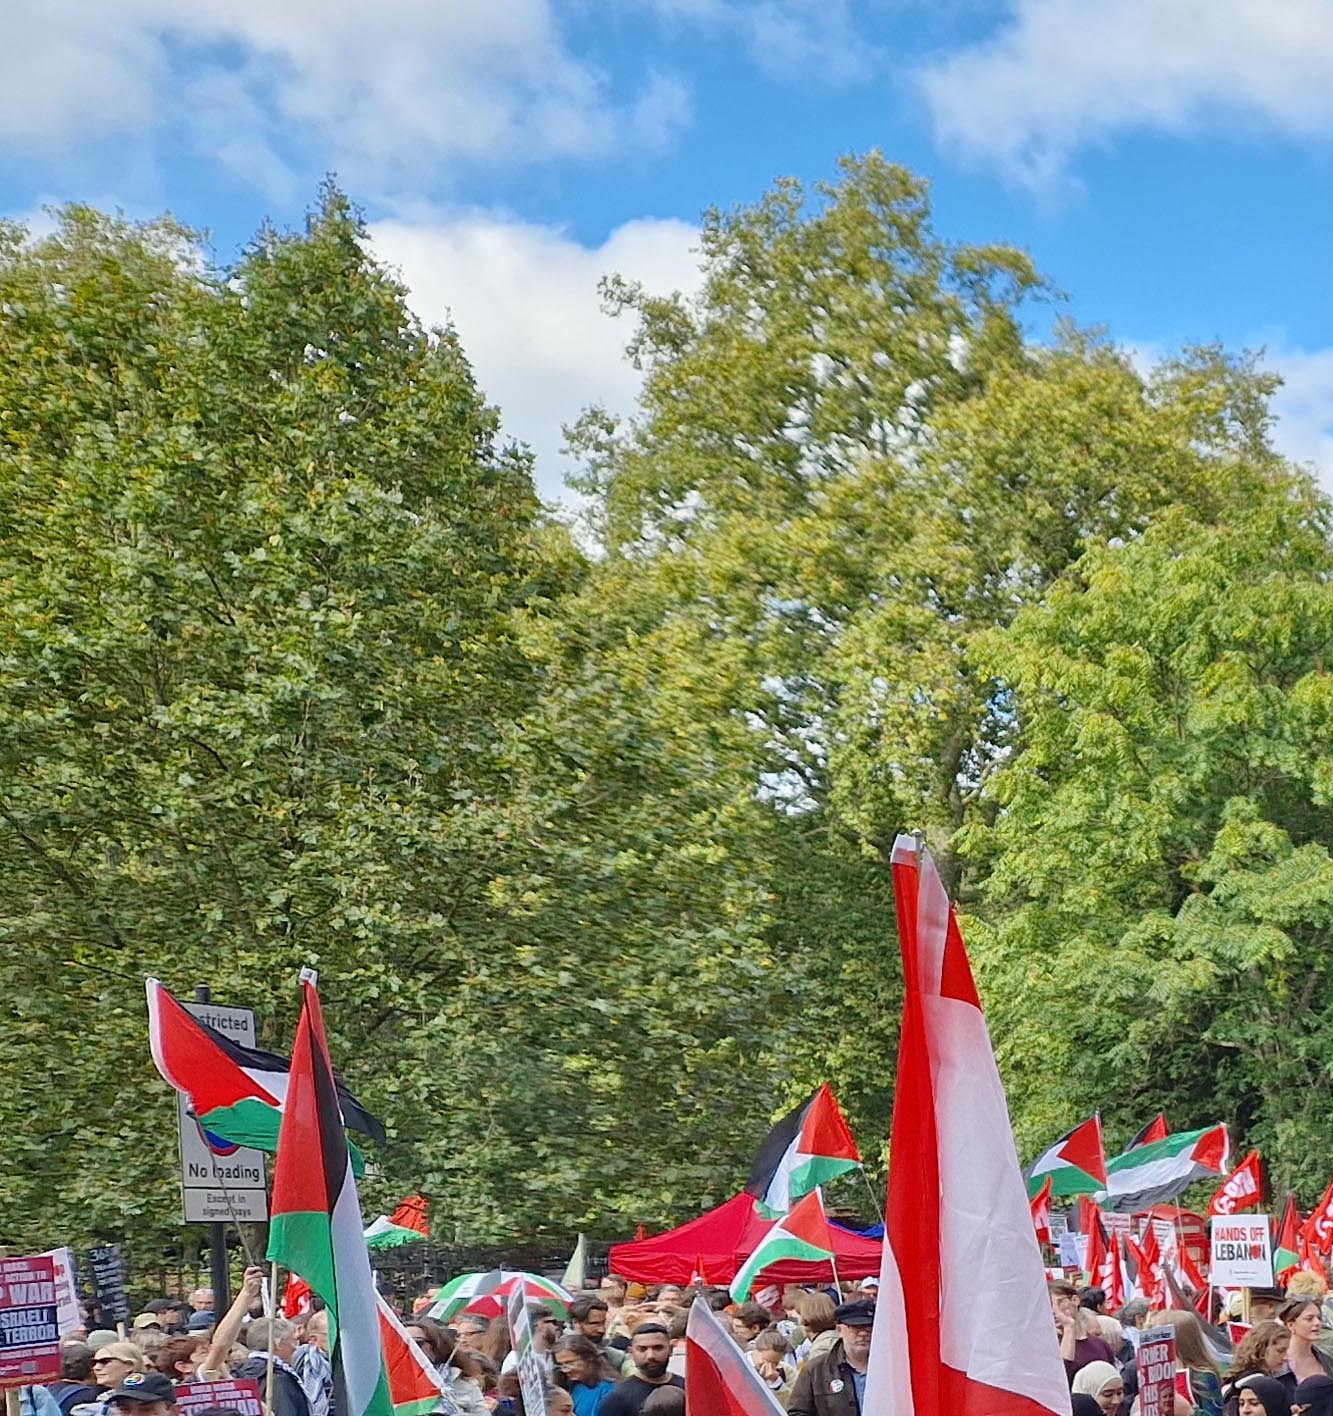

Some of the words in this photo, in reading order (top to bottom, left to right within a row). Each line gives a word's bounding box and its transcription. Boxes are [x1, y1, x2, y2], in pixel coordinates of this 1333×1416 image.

[189, 1163, 208, 1178] No
[1215, 1227, 1246, 1241] HANDS
[1249, 1227, 1264, 1241] OFF
[8, 1281, 54, 1305] WAR
[1, 1308, 49, 1328] SRAELI
[3, 1324, 56, 1345] TERROR
